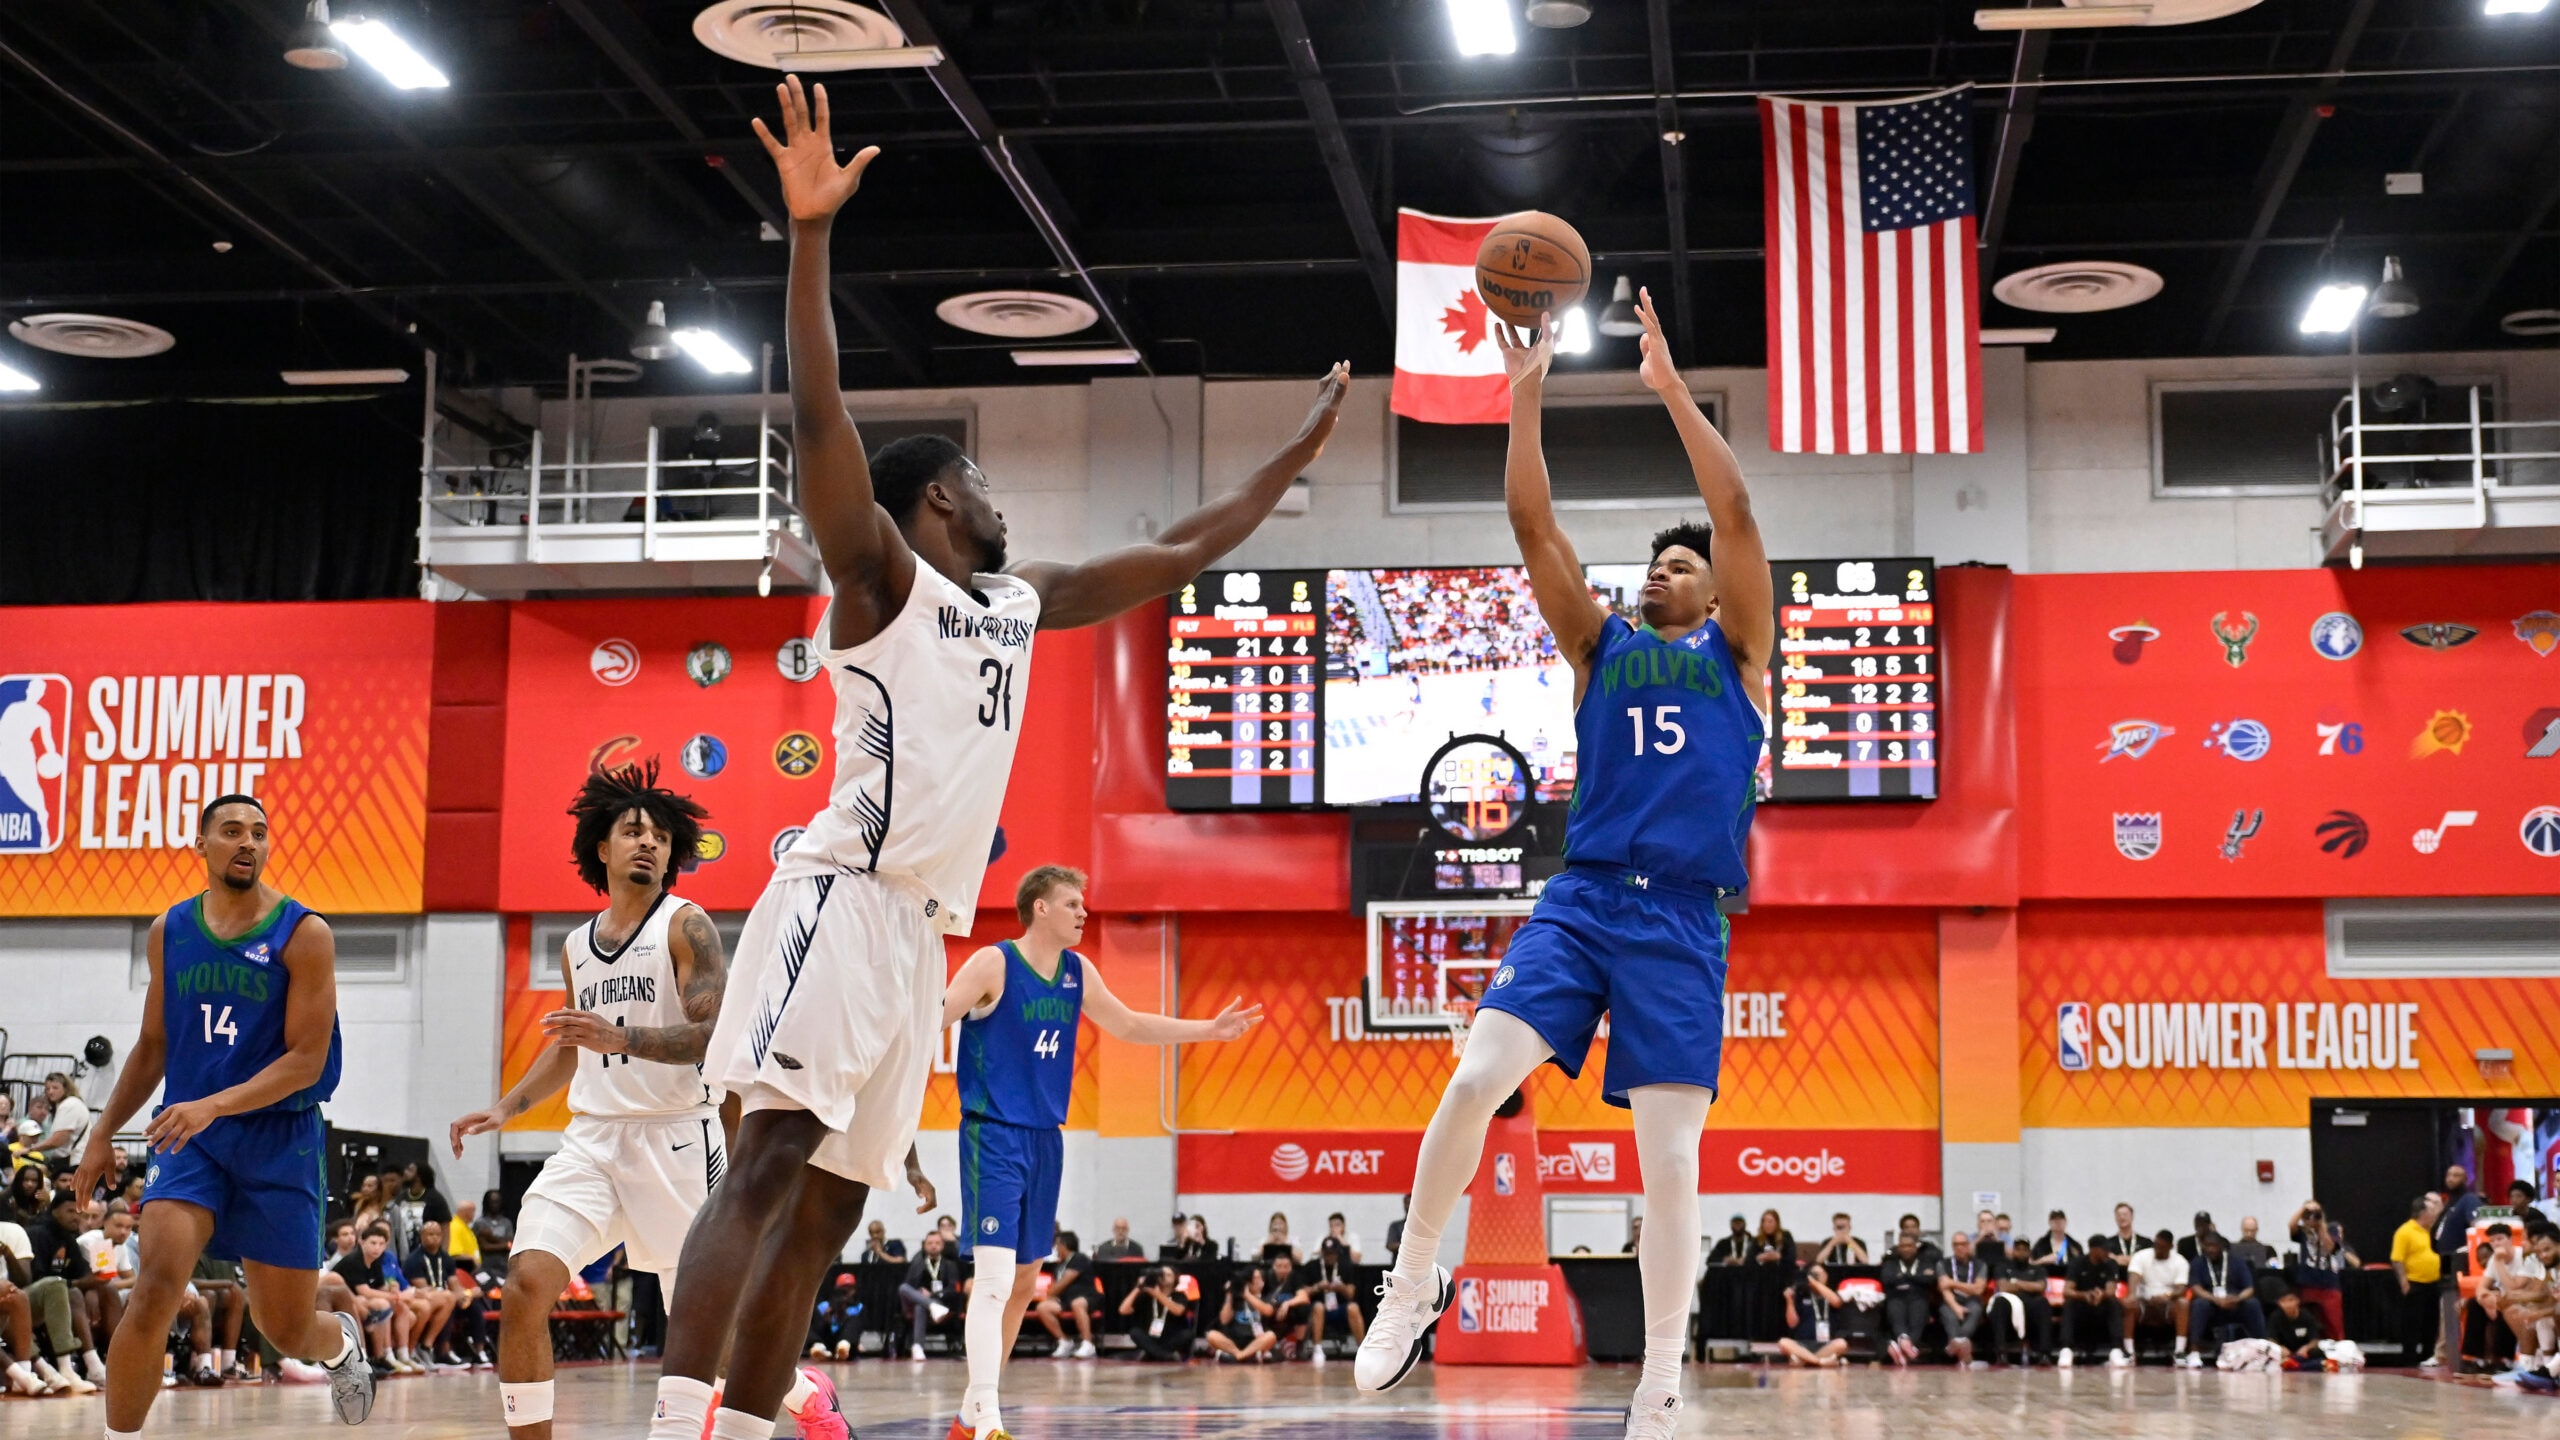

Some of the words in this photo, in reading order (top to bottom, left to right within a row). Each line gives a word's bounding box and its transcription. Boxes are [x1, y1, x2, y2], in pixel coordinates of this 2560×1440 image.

[1293, 581, 1308, 601] 5
[1791, 571, 1808, 592] 2
[1907, 569, 1924, 590] 2
[1180, 583, 1196, 604] 2
[1236, 637, 1260, 657] 21
[1269, 636, 1284, 656] 4
[1293, 636, 1308, 656] 4
[1855, 627, 1871, 647] 2
[1884, 626, 1900, 646] 4
[1913, 626, 1925, 645] 1
[1240, 667, 1255, 687] 2
[1269, 666, 1284, 685] 0
[1298, 665, 1308, 684] 1
[1601, 650, 1723, 699] WOLVES
[1851, 657, 1877, 677] 18
[1886, 656, 1901, 676] 5
[1914, 654, 1926, 674] 1
[978, 658, 1014, 731] 31
[1236, 693, 1261, 713] 12
[1269, 693, 1284, 713] 3
[1294, 692, 1309, 712] 2
[1851, 683, 1878, 704] 12
[1885, 684, 1901, 704] 2
[1912, 682, 1928, 703] 2
[86, 674, 305, 761] SUMMER
[1856, 713, 1872, 733] 0
[1889, 712, 1901, 732] 1
[1912, 713, 1928, 733] 3
[1240, 722, 1255, 742] 0
[1269, 721, 1283, 741] 3
[1298, 722, 1308, 742] 1
[1627, 705, 1686, 756] 15
[2316, 722, 2364, 756] 76
[1240, 749, 1254, 770] 2
[1269, 750, 1284, 770] 2
[1298, 749, 1308, 769] 1
[1856, 741, 1873, 761] 7
[1888, 741, 1903, 762] 3
[1917, 740, 1929, 761] 1
[1467, 786, 1508, 830] 16
[1458, 848, 1523, 862] TISSOT
[176, 961, 269, 1002] WOLVES
[579, 983, 598, 1012] NEW
[601, 976, 656, 1006] ORLEANS
[200, 1003, 238, 1046] 14
[2098, 1002, 2267, 1069] SUMMER
[2276, 1002, 2419, 1069] LEAGUE
[1033, 1029, 1060, 1059] 44
[1314, 1150, 1385, 1174] AT&T
[1537, 1147, 1613, 1177] eraVe
[1738, 1147, 1845, 1183] Google
[1486, 1279, 1549, 1307] SUMMER
[1486, 1305, 1538, 1333] LEAGUE
